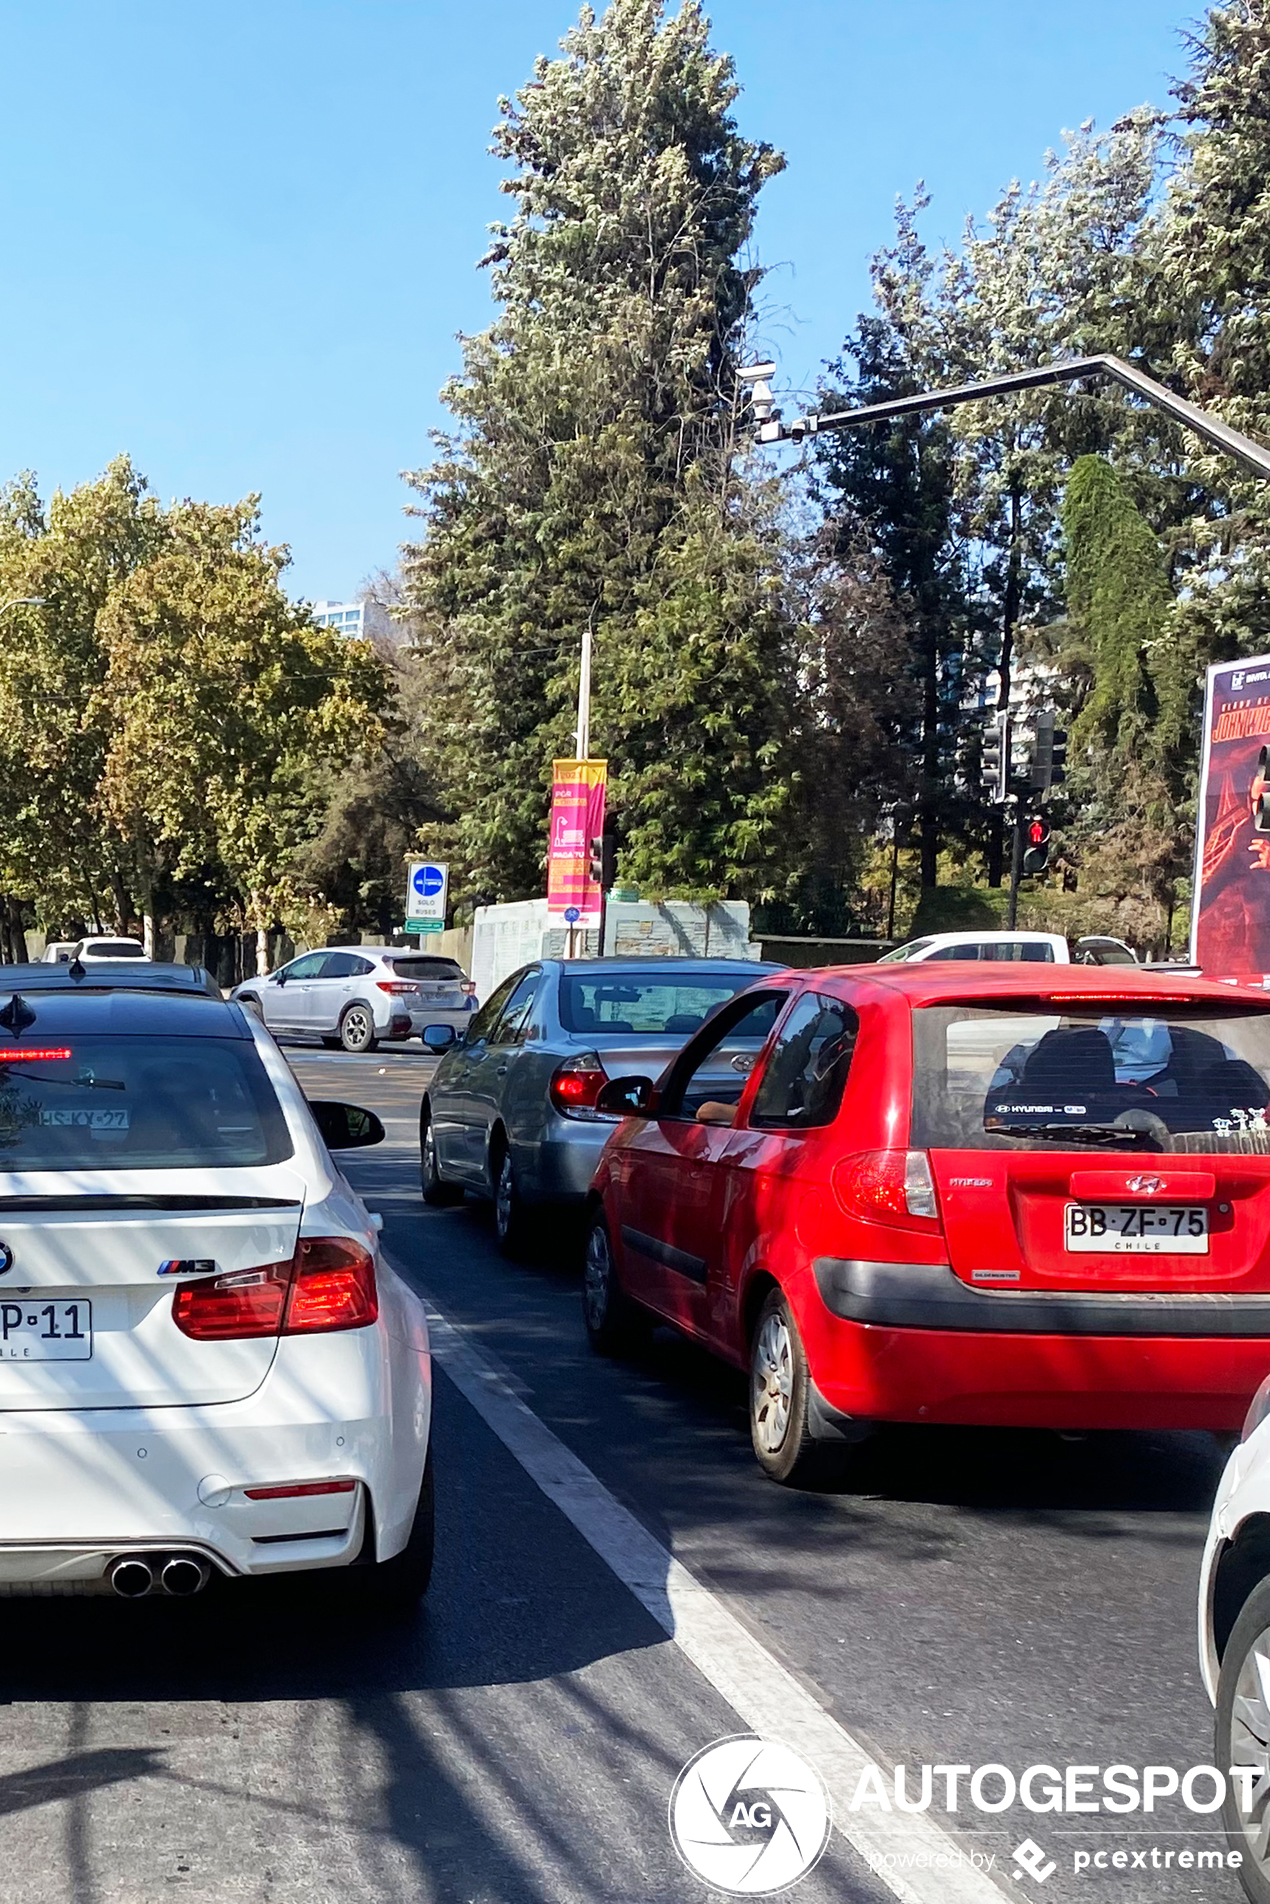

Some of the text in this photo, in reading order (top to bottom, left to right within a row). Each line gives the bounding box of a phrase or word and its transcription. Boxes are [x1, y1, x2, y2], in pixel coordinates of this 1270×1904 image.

[1211, 709, 1245, 743] JOHN
[1011, 1105, 1053, 1113] HYUNDAI
[1114, 1242, 1161, 1250] CHILE
